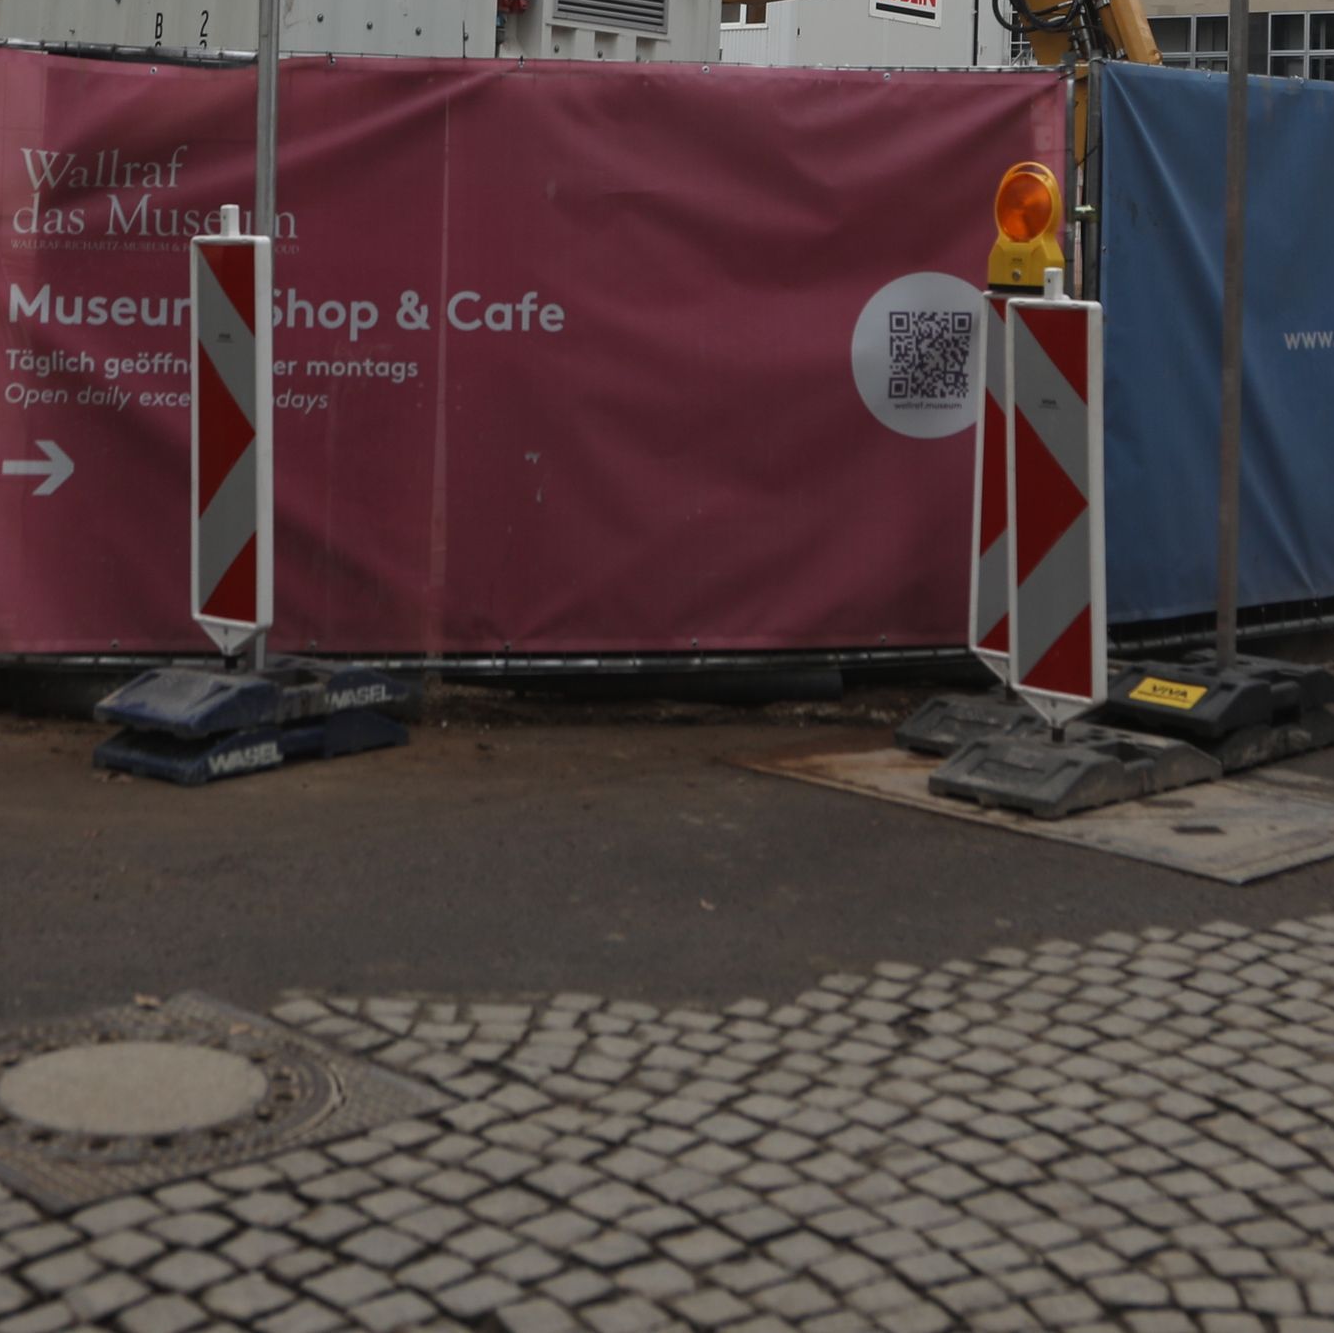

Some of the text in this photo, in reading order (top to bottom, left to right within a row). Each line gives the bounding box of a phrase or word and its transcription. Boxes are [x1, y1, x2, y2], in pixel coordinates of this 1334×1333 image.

[155, 10, 209, 39] B 2
[19, 145, 187, 190] Wallraf
[12, 192, 86, 235] das
[396, 290, 430, 329] &
[447, 291, 565, 331] Cafe
[6, 348, 95, 377] Täglich
[104, 352, 191, 379] geöffn
[307, 358, 418, 383] montags
[5, 382, 68, 409] Open
[77, 385, 131, 411] daily
[139, 388, 191, 408] exce
[208, 739, 284, 773] WASEL
